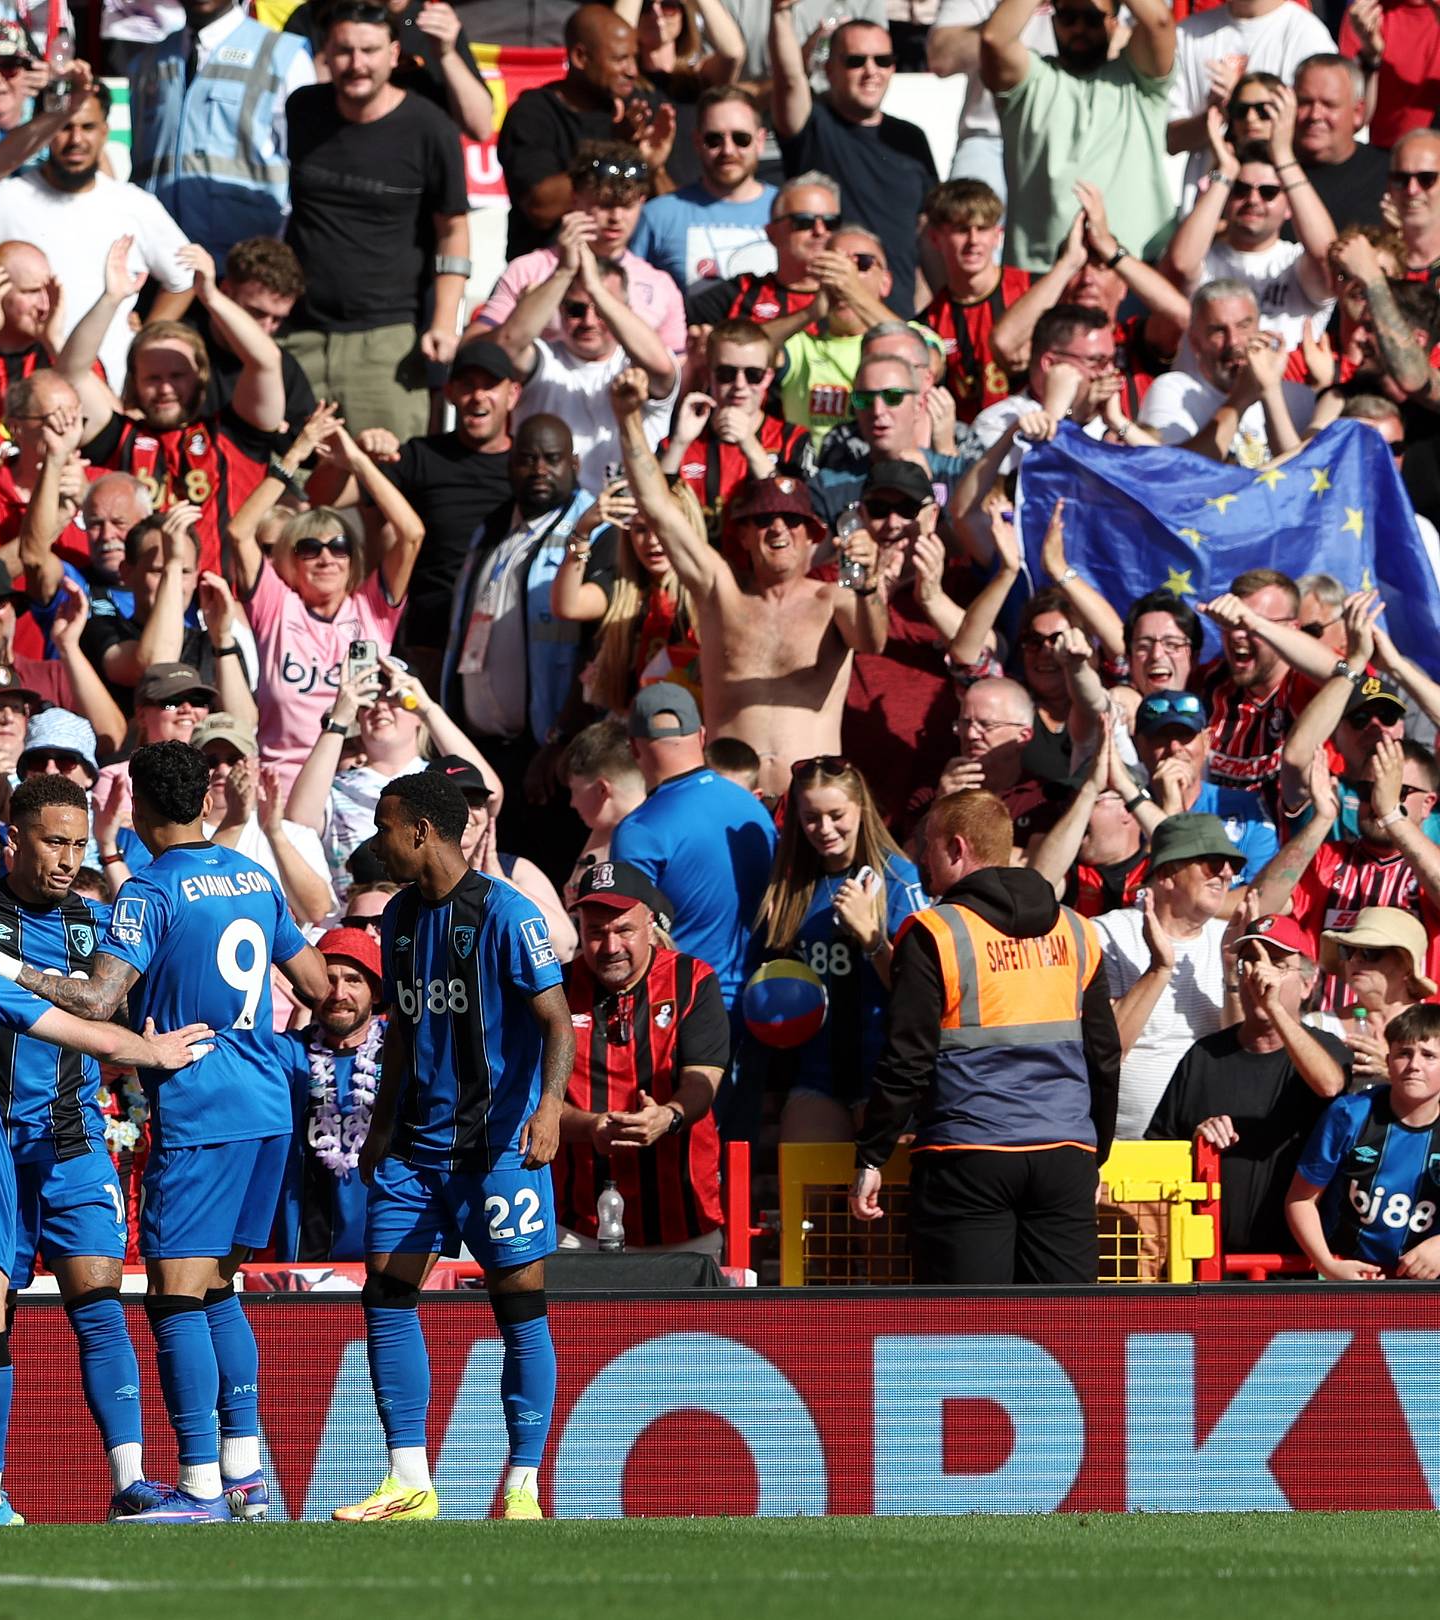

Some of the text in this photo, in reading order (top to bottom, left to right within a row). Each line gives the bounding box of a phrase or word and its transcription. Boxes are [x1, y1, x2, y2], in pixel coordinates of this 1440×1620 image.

[282, 653, 343, 694] bj8
[181, 871, 272, 903] EVANILSON
[216, 918, 266, 1029] 9
[531, 948, 557, 966] LEO
[987, 935, 1069, 973] SAFETY TEAM
[397, 978, 468, 1024] bj88
[484, 1188, 544, 1240] 22
[1349, 1179, 1436, 1233] bj88
[233, 1383, 257, 1396] AFC
[257, 1330, 1440, 1518] WORK
